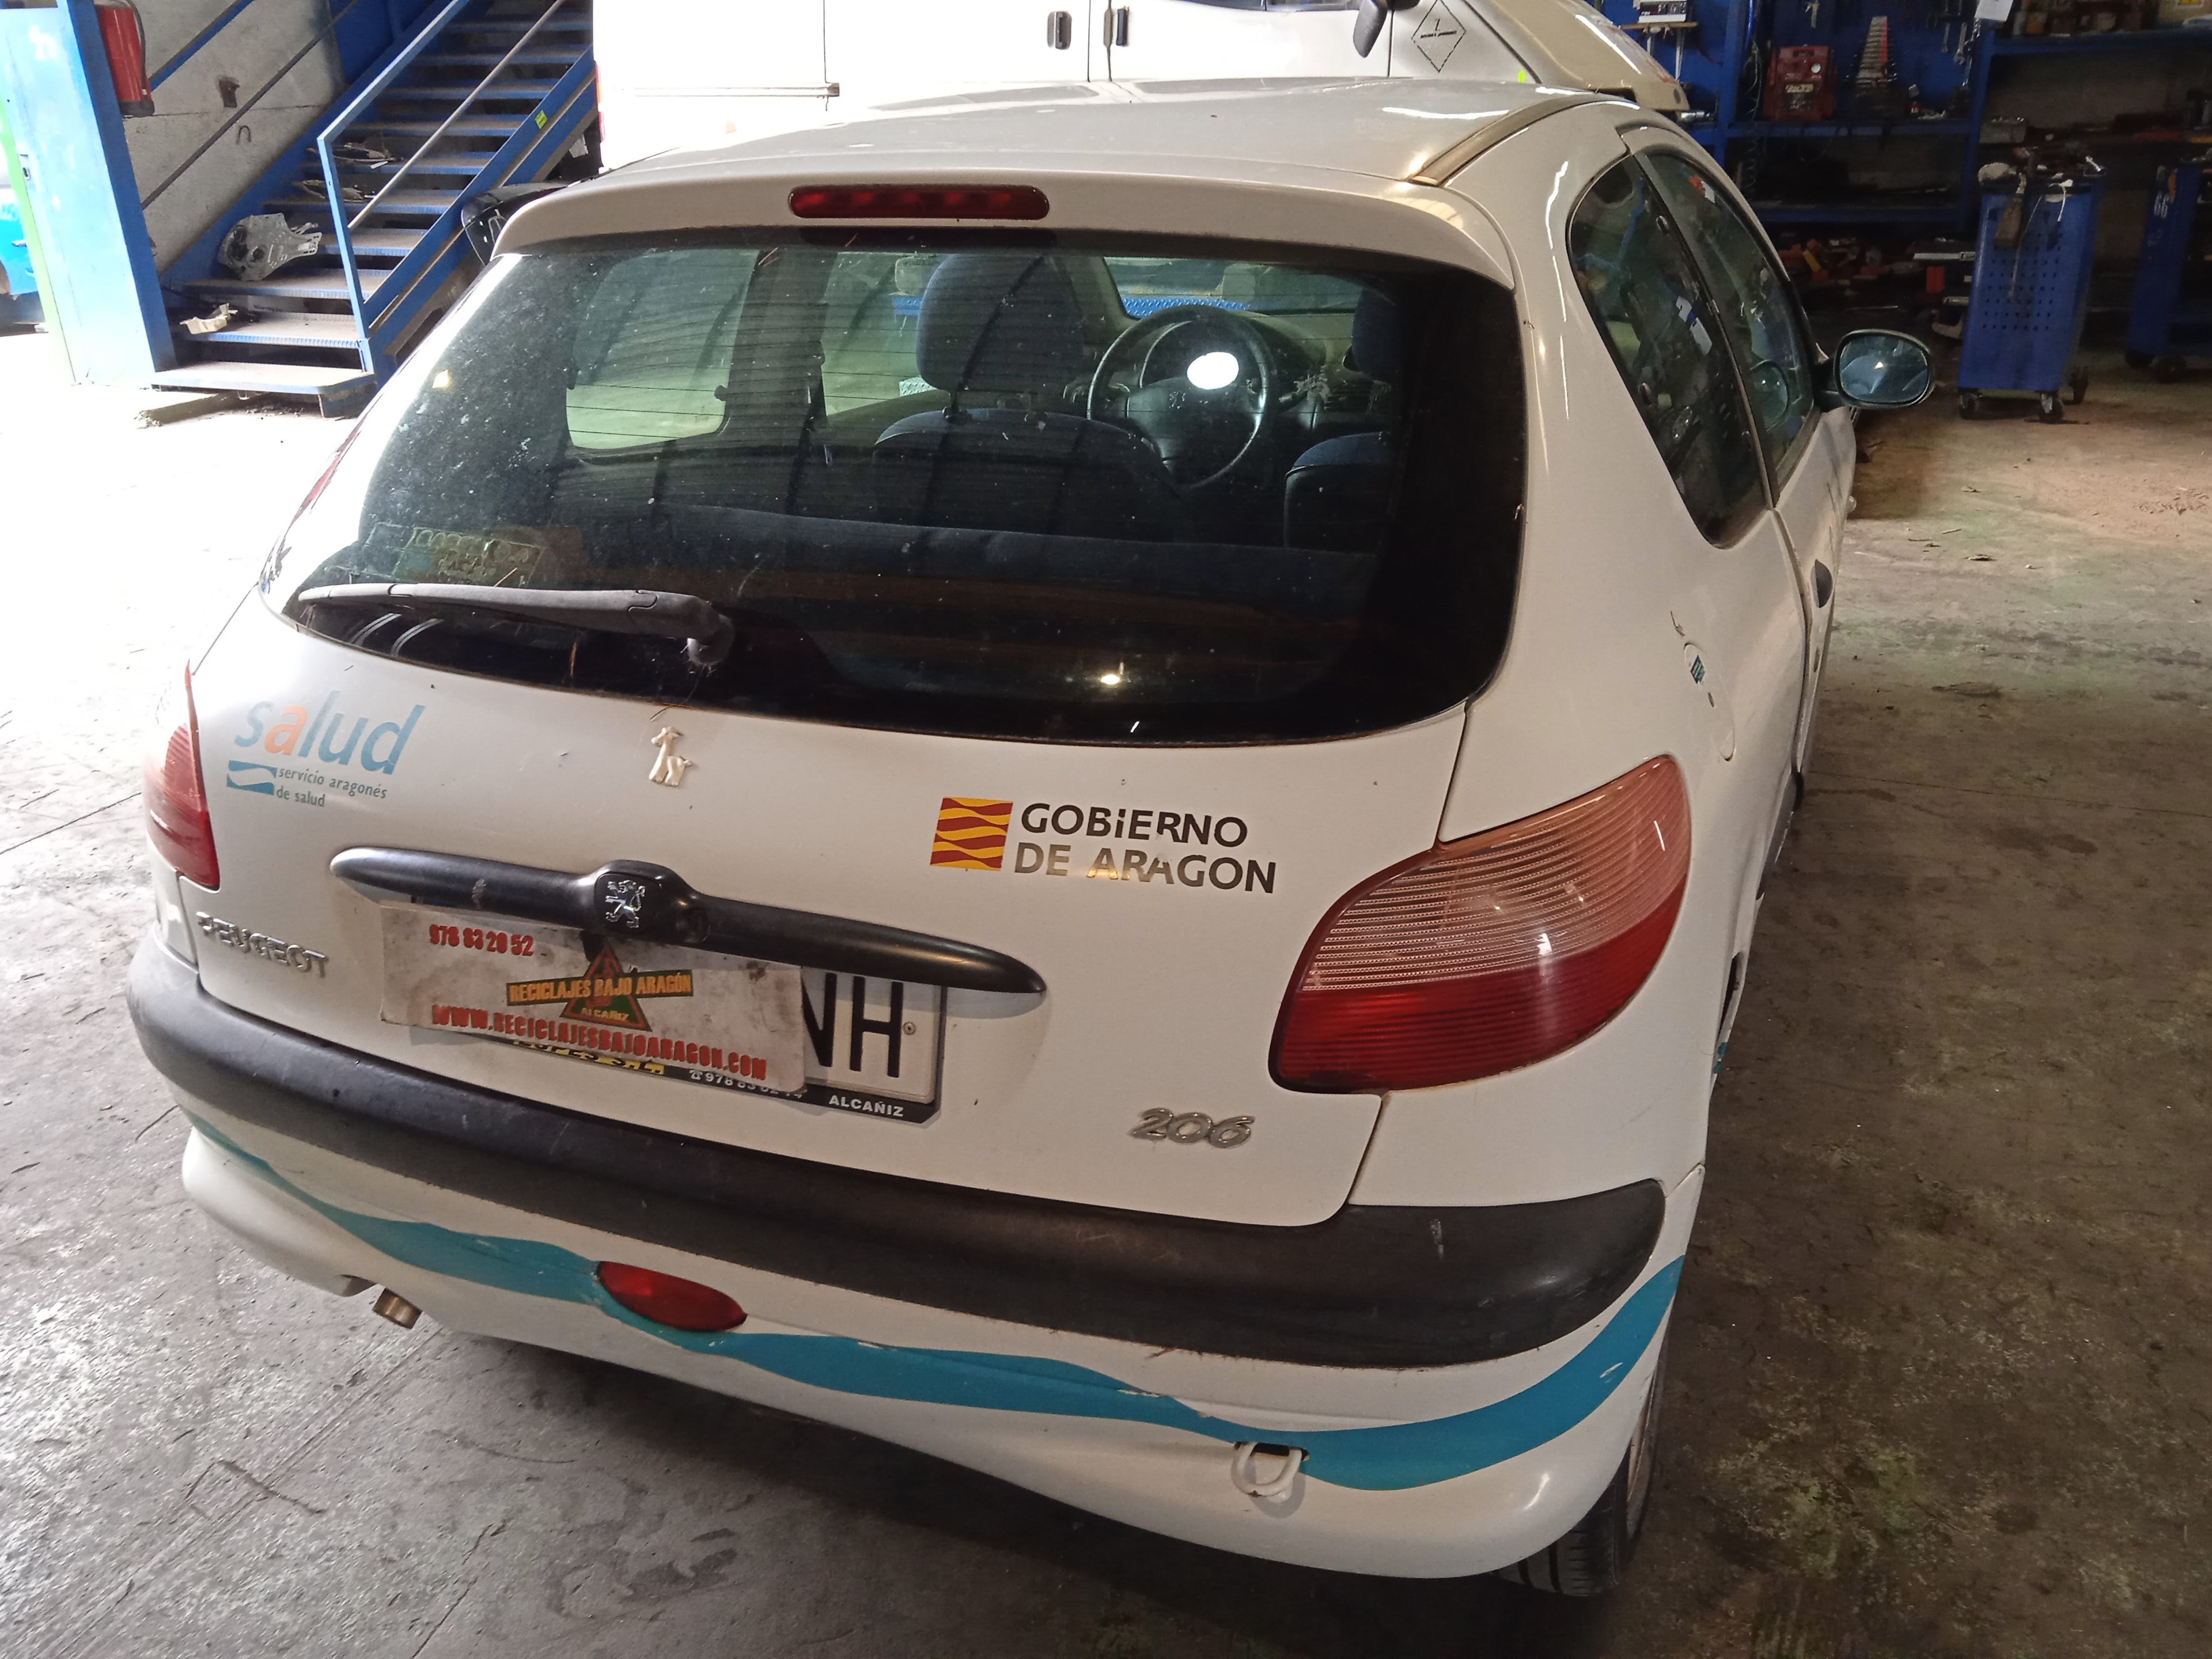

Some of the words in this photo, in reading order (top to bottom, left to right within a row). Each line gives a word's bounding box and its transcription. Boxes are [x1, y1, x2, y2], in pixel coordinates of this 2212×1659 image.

[233, 690, 426, 775] salud
[276, 786, 290, 800] de
[294, 791, 326, 807] salud
[278, 767, 324, 785] servicio
[329, 778, 387, 799] aragonés
[1014, 842, 1071, 876] DE
[1085, 847, 1277, 893] ARAGON
[196, 911, 328, 978] PEUGEOT
[486, 931, 507, 954] 20
[511, 934, 534, 957] 52
[509, 980, 591, 1002] RECICLAJES
[593, 978, 632, 997] BAJO
[828, 1094, 904, 1117] ALCAÑIZ
[1127, 1107, 1256, 1149] 206
